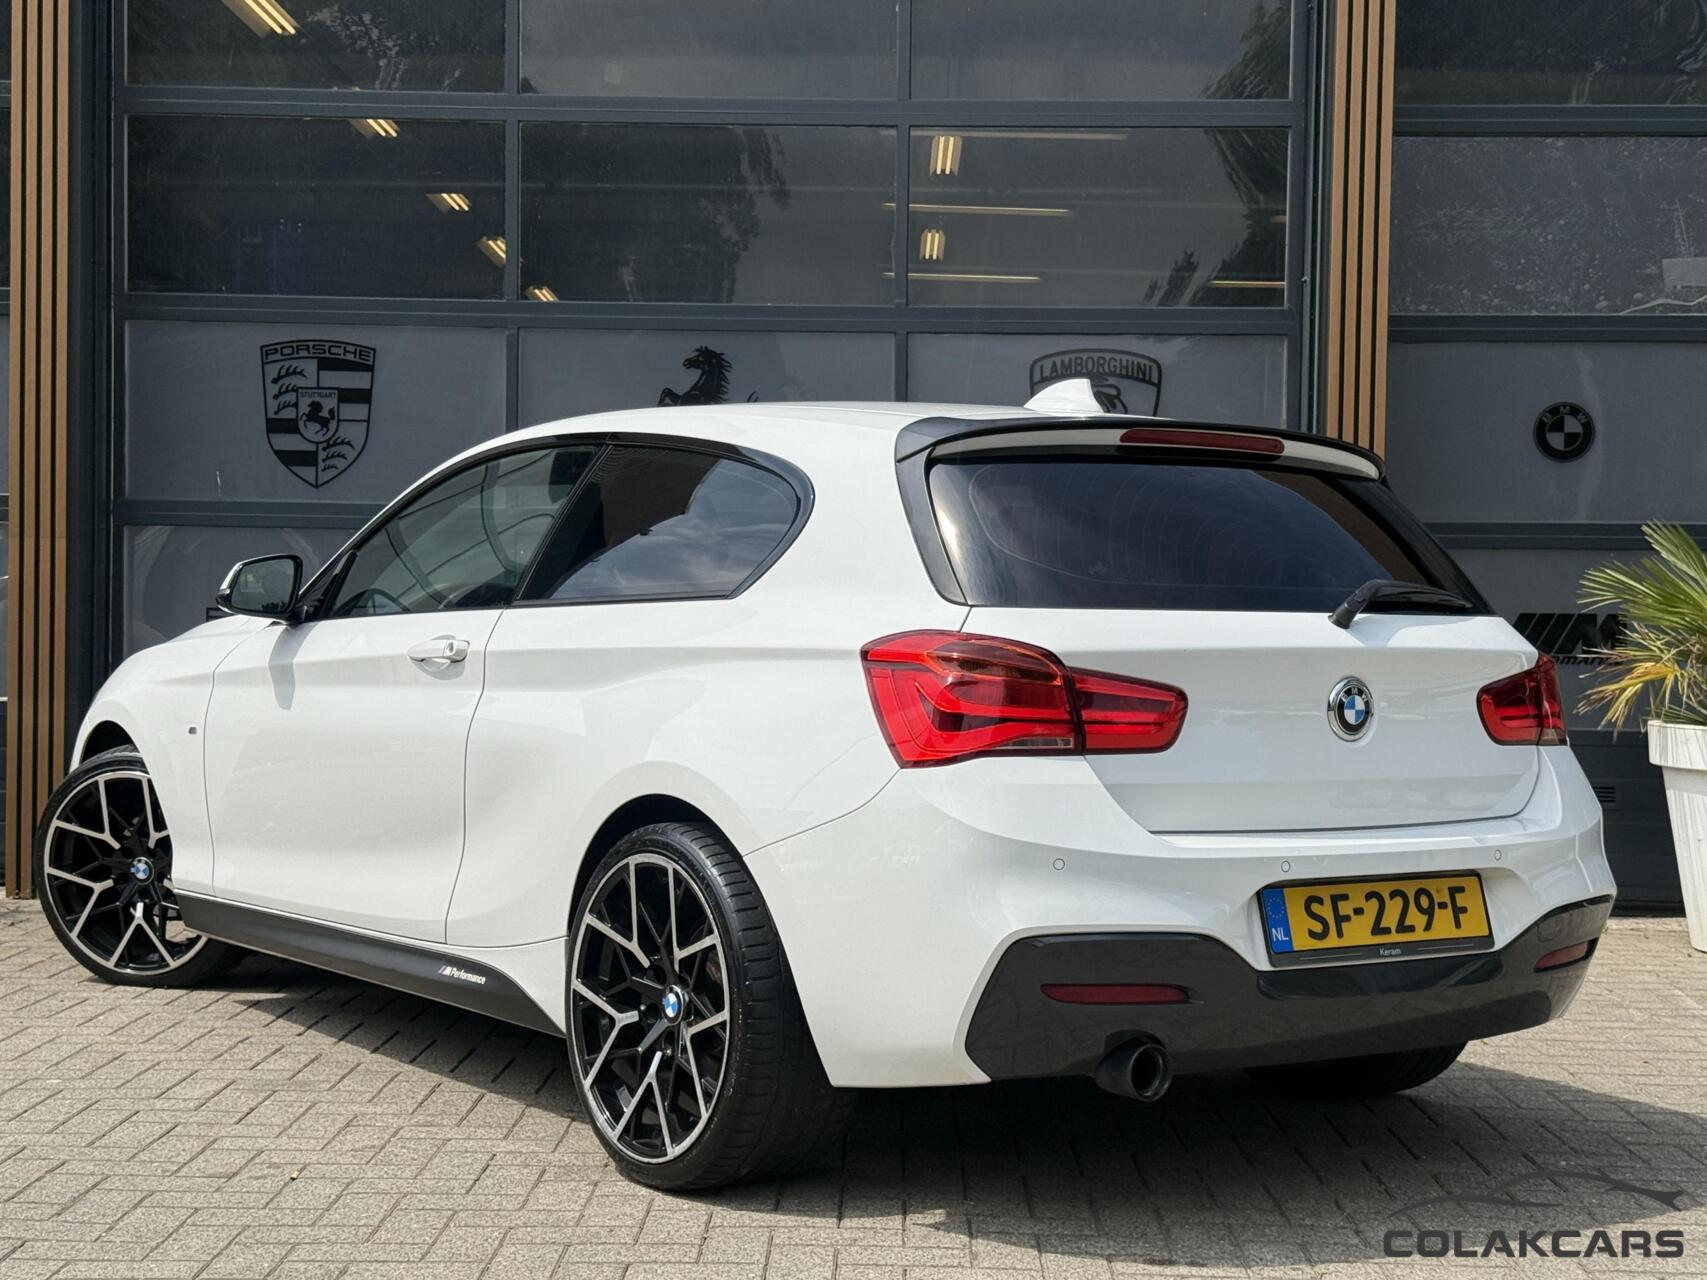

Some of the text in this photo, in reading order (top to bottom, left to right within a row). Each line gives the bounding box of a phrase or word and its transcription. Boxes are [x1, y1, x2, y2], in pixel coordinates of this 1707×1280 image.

[264, 343, 372, 363] PORSCHE
[1039, 355, 1154, 386] LAMBORGHINI
[1541, 404, 1588, 424] BMW
[1303, 885, 1469, 941] SF-229-F
[1271, 927, 1289, 942] NL
